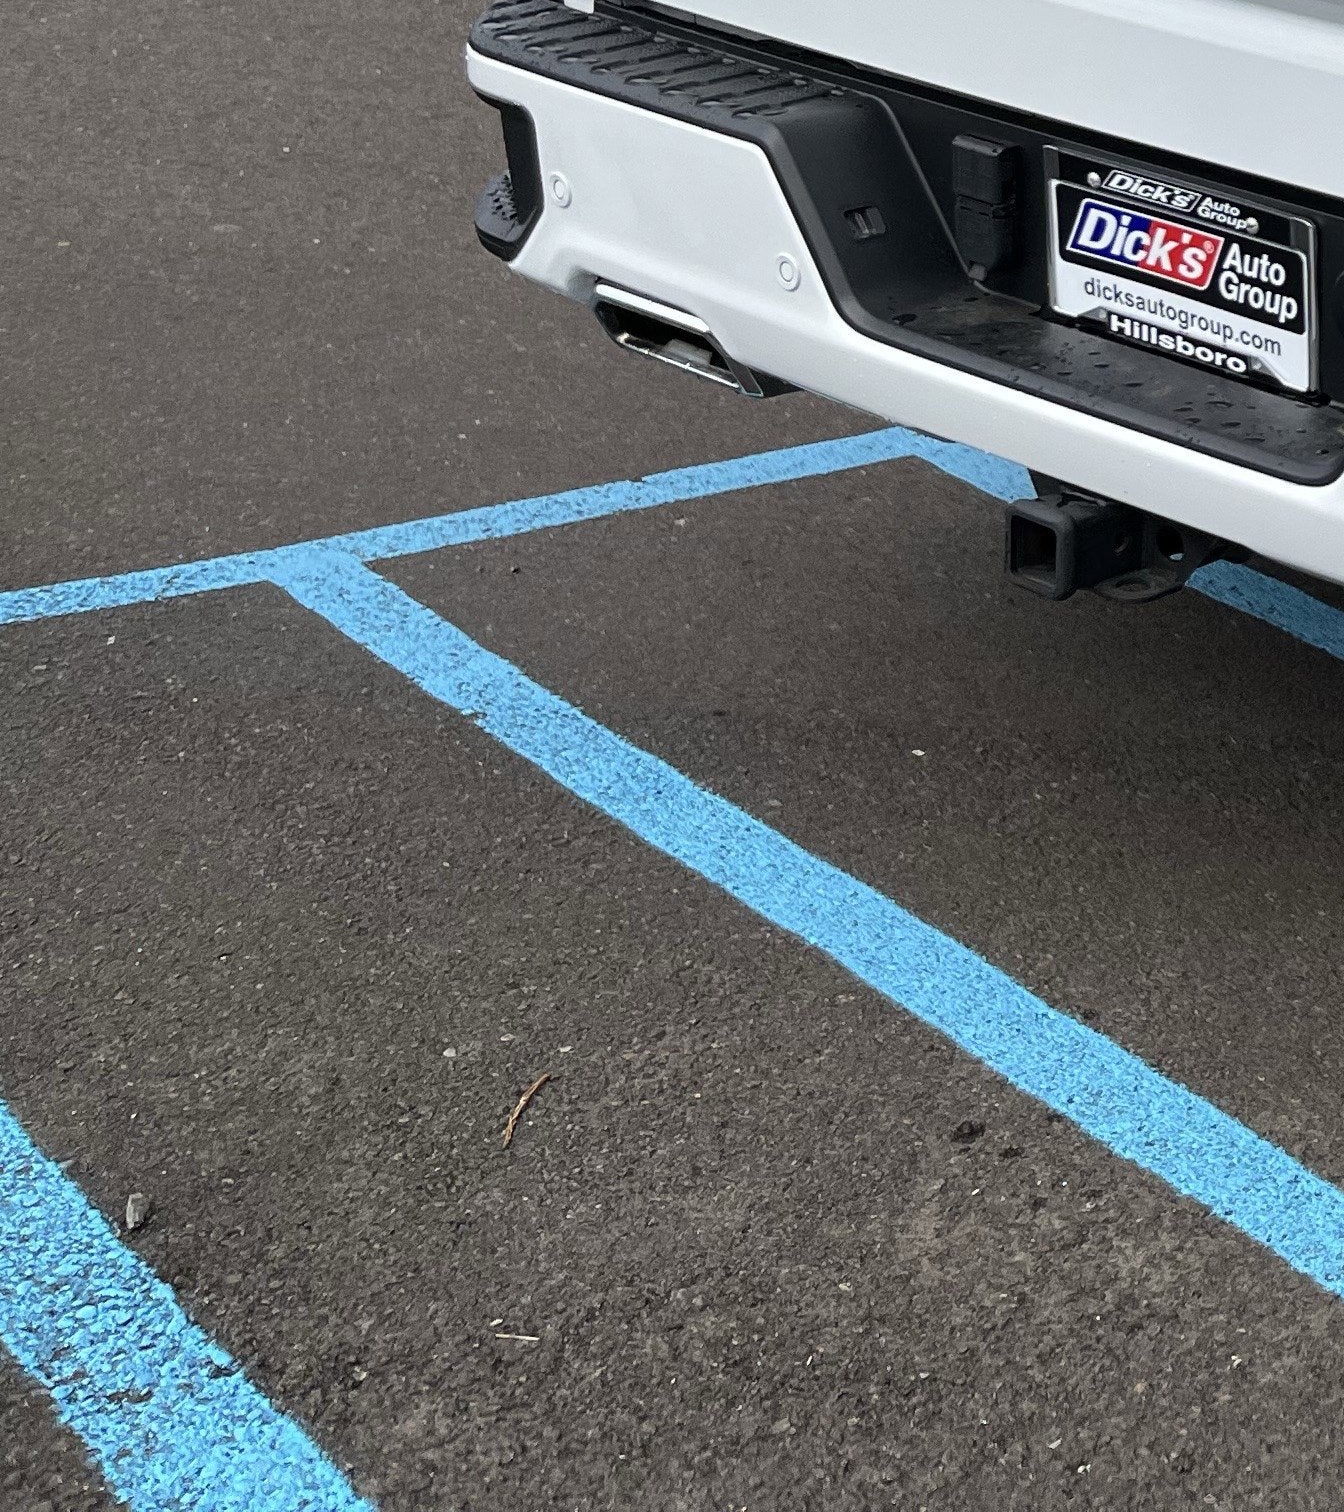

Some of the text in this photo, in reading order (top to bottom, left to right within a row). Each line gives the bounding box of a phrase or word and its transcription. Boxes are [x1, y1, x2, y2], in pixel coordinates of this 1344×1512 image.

[1106, 172, 1195, 211] Dick's
[1200, 196, 1241, 217] Auto
[1198, 207, 1249, 231] Group
[1076, 207, 1209, 281] Dick's
[1222, 242, 1286, 287] Auto
[1083, 277, 1282, 356] dicksautogroup.com
[1218, 271, 1298, 324] Group
[1109, 313, 1248, 374] Hillsboro
